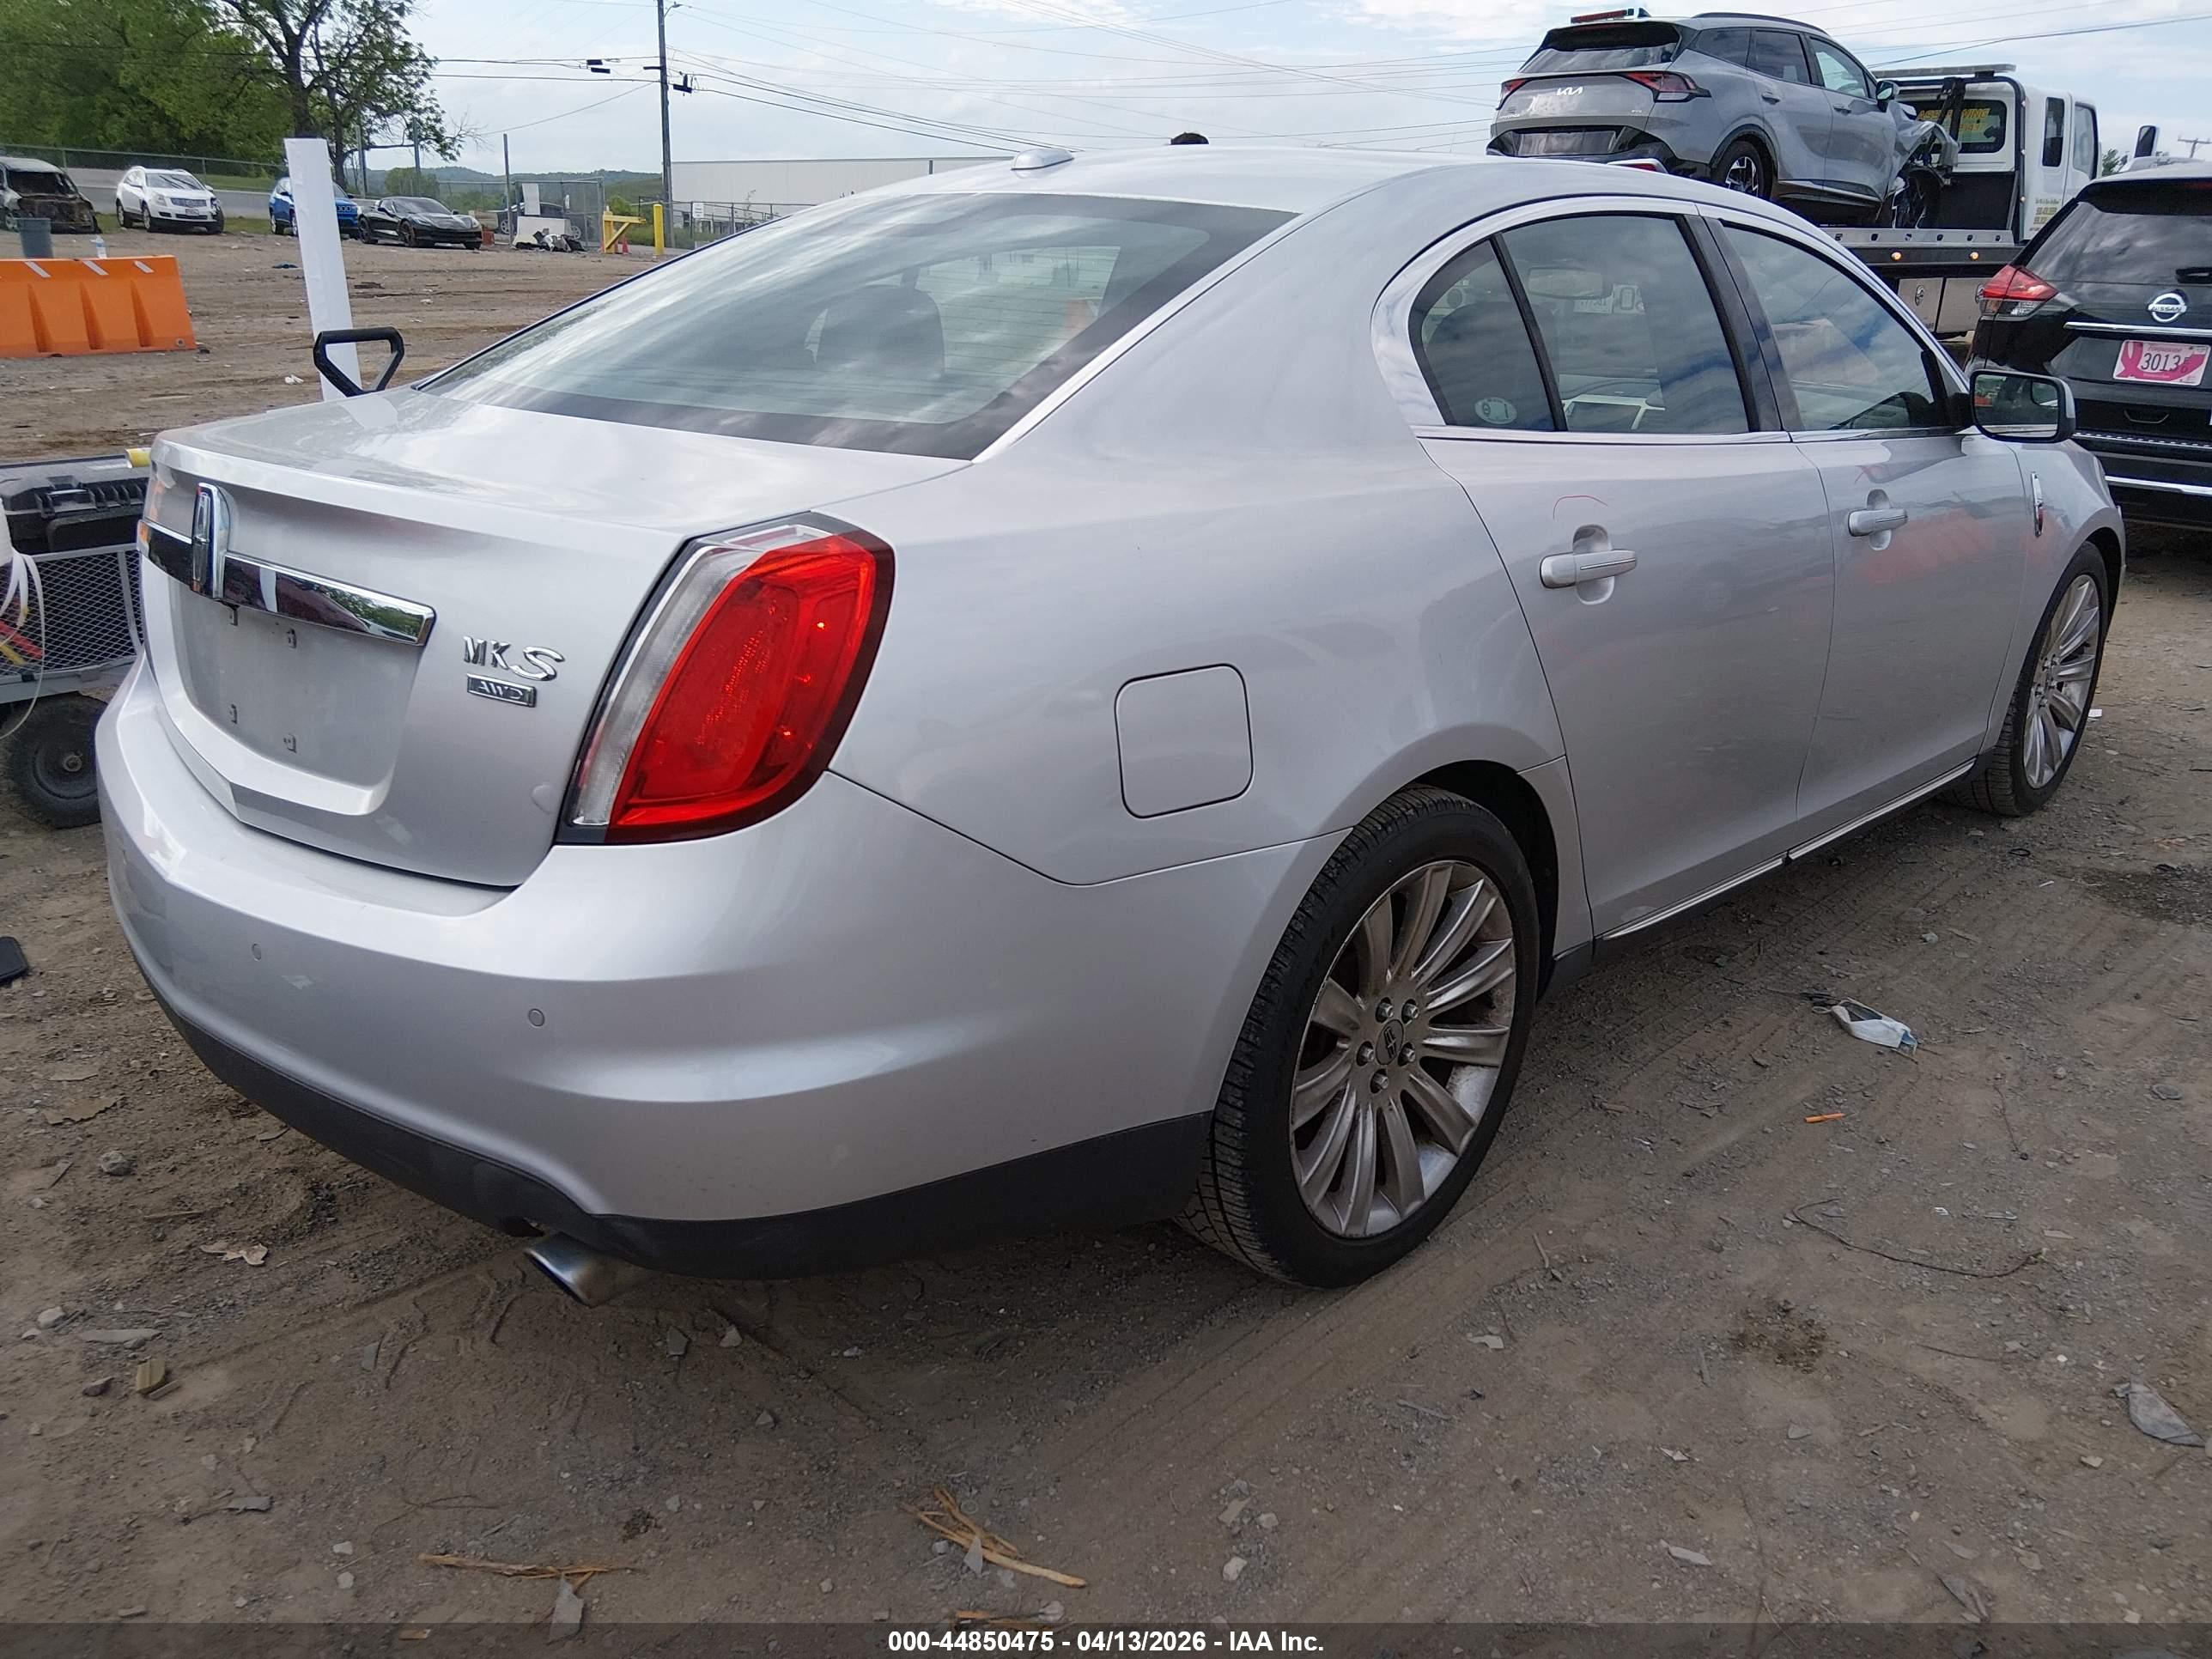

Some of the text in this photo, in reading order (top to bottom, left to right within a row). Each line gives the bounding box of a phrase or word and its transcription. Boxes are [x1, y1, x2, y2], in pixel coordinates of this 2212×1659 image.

[1556, 86, 1583, 96] KIA
[463, 635, 566, 681] MKS
[477, 680, 525, 700] AWD
